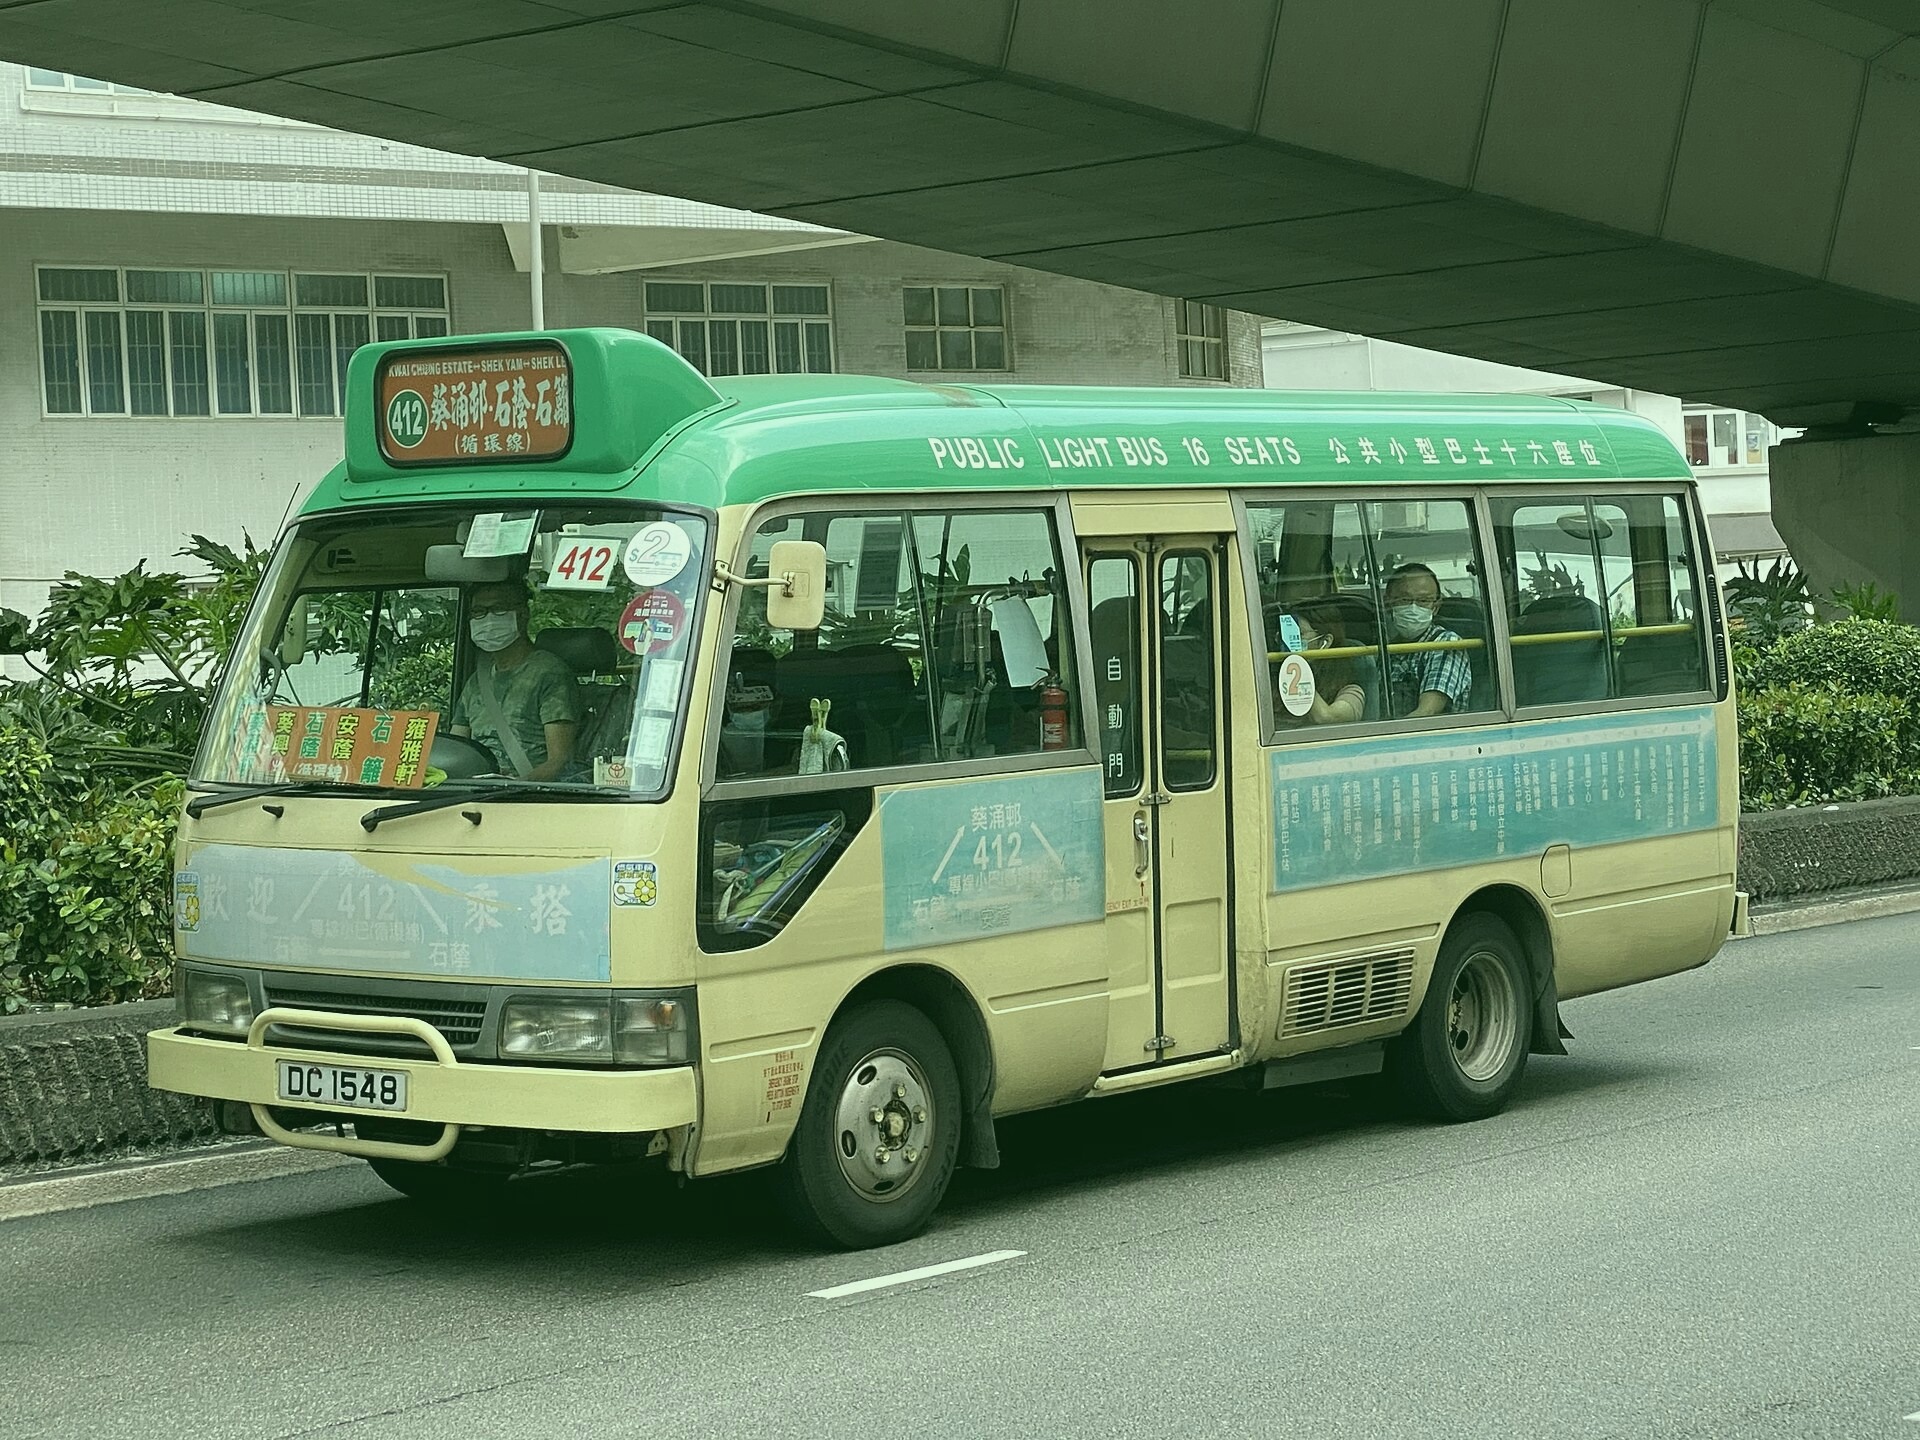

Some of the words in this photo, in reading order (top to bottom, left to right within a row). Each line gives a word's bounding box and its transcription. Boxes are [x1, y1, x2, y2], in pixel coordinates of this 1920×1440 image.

[388, 365, 410, 378] KWAI
[442, 361, 474, 375] ESTATE
[481, 360, 504, 373] SHEK
[506, 359, 523, 372] YAM
[531, 357, 554, 370] SHEK
[391, 399, 423, 436] 412
[927, 437, 1025, 469] PUBLIC
[1037, 437, 1114, 468] LIGHT
[1115, 436, 1169, 466] BUS
[1181, 437, 1210, 466] 16
[1223, 436, 1301, 465] SEATS
[557, 546, 611, 582] 412
[271, 710, 297, 756] 葵興
[298, 711, 327, 759] 石蔭
[1107, 655, 1123, 778] 自動門
[330, 713, 360, 761] 安蔭
[359, 714, 394, 785] 石籬
[393, 717, 429, 786] 雍雅軒
[970, 802, 1022, 832] 葵涌邨
[973, 831, 1023, 871] 412
[336, 882, 396, 921] 412
[288, 1065, 323, 1098] DC
[332, 1069, 397, 1105] 1548
